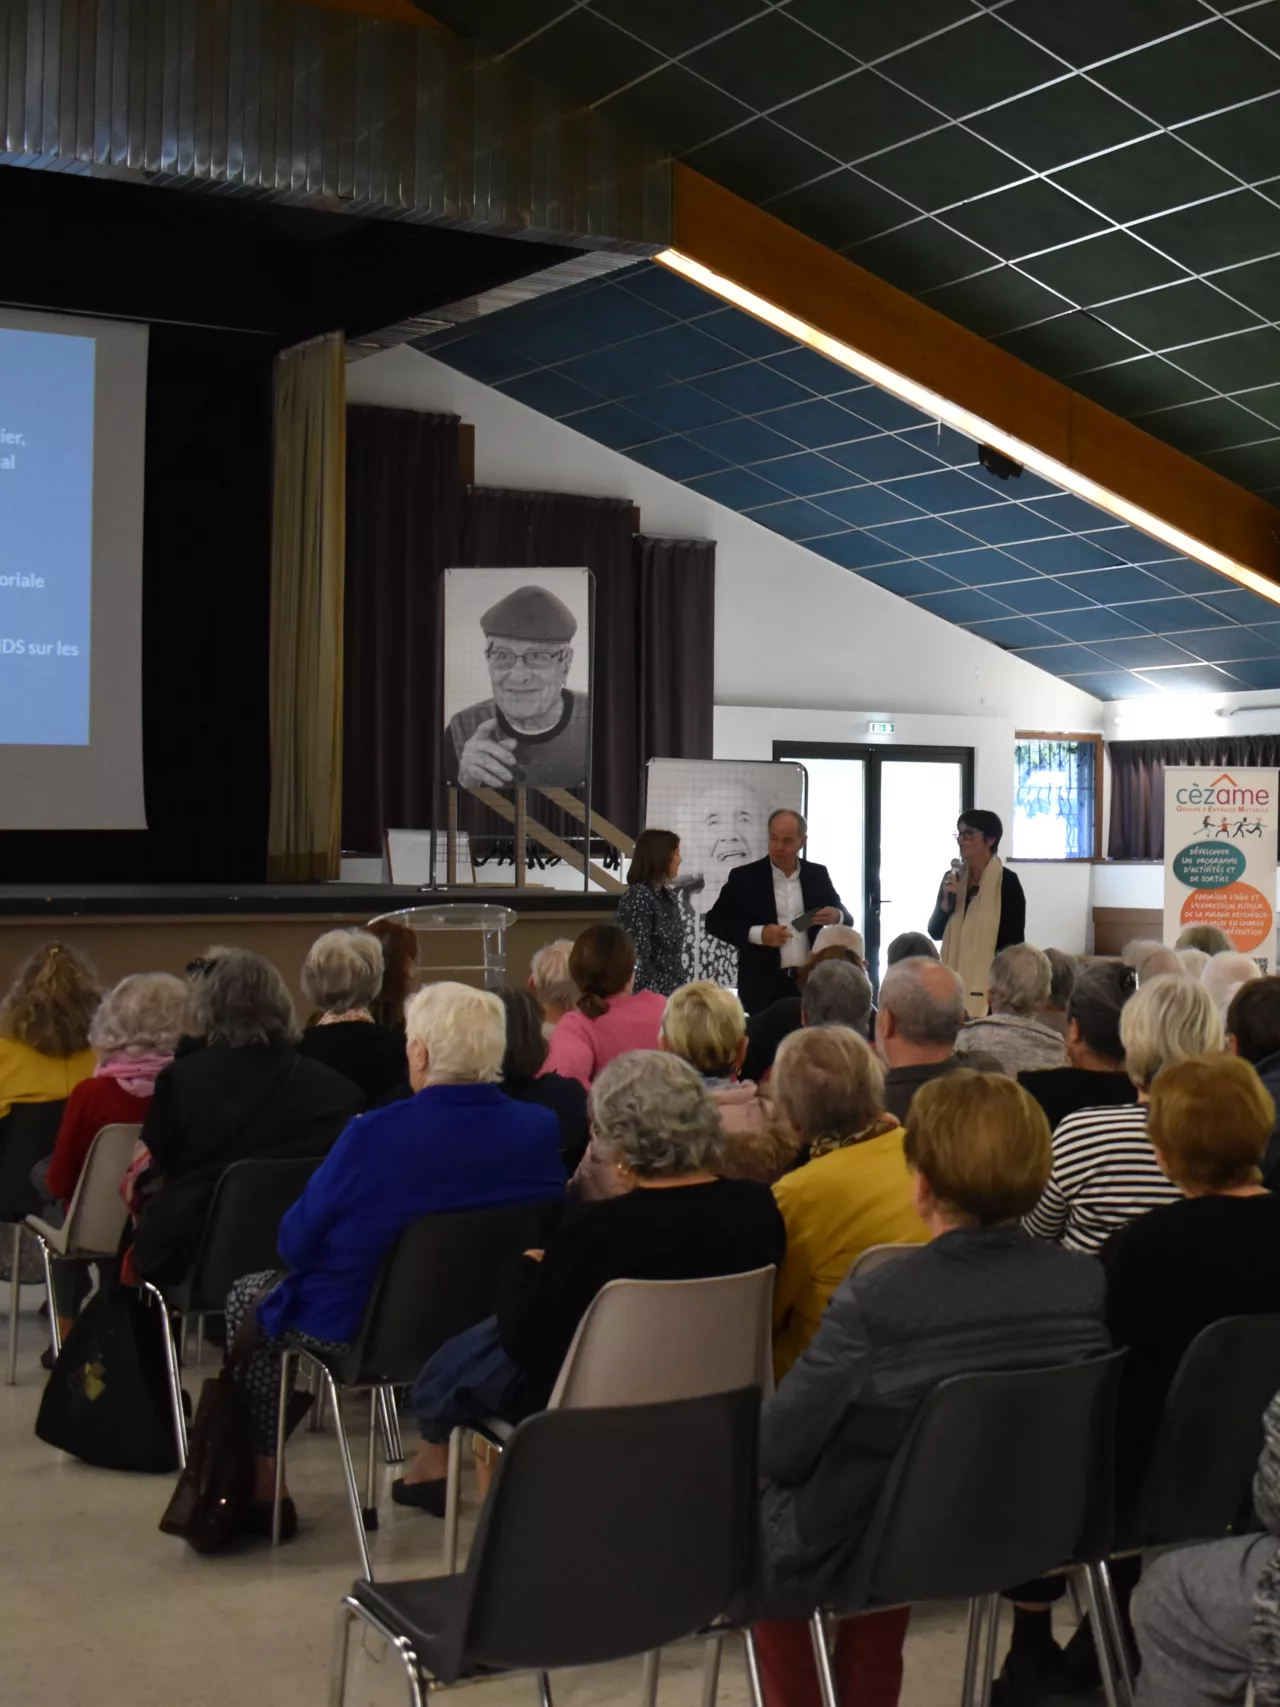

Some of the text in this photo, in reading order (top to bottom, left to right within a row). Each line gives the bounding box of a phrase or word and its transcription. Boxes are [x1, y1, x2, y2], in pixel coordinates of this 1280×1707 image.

[28, 643, 54, 655] sur
[57, 640, 80, 656] les
[1196, 857, 1238, 865] PROGRAMME
